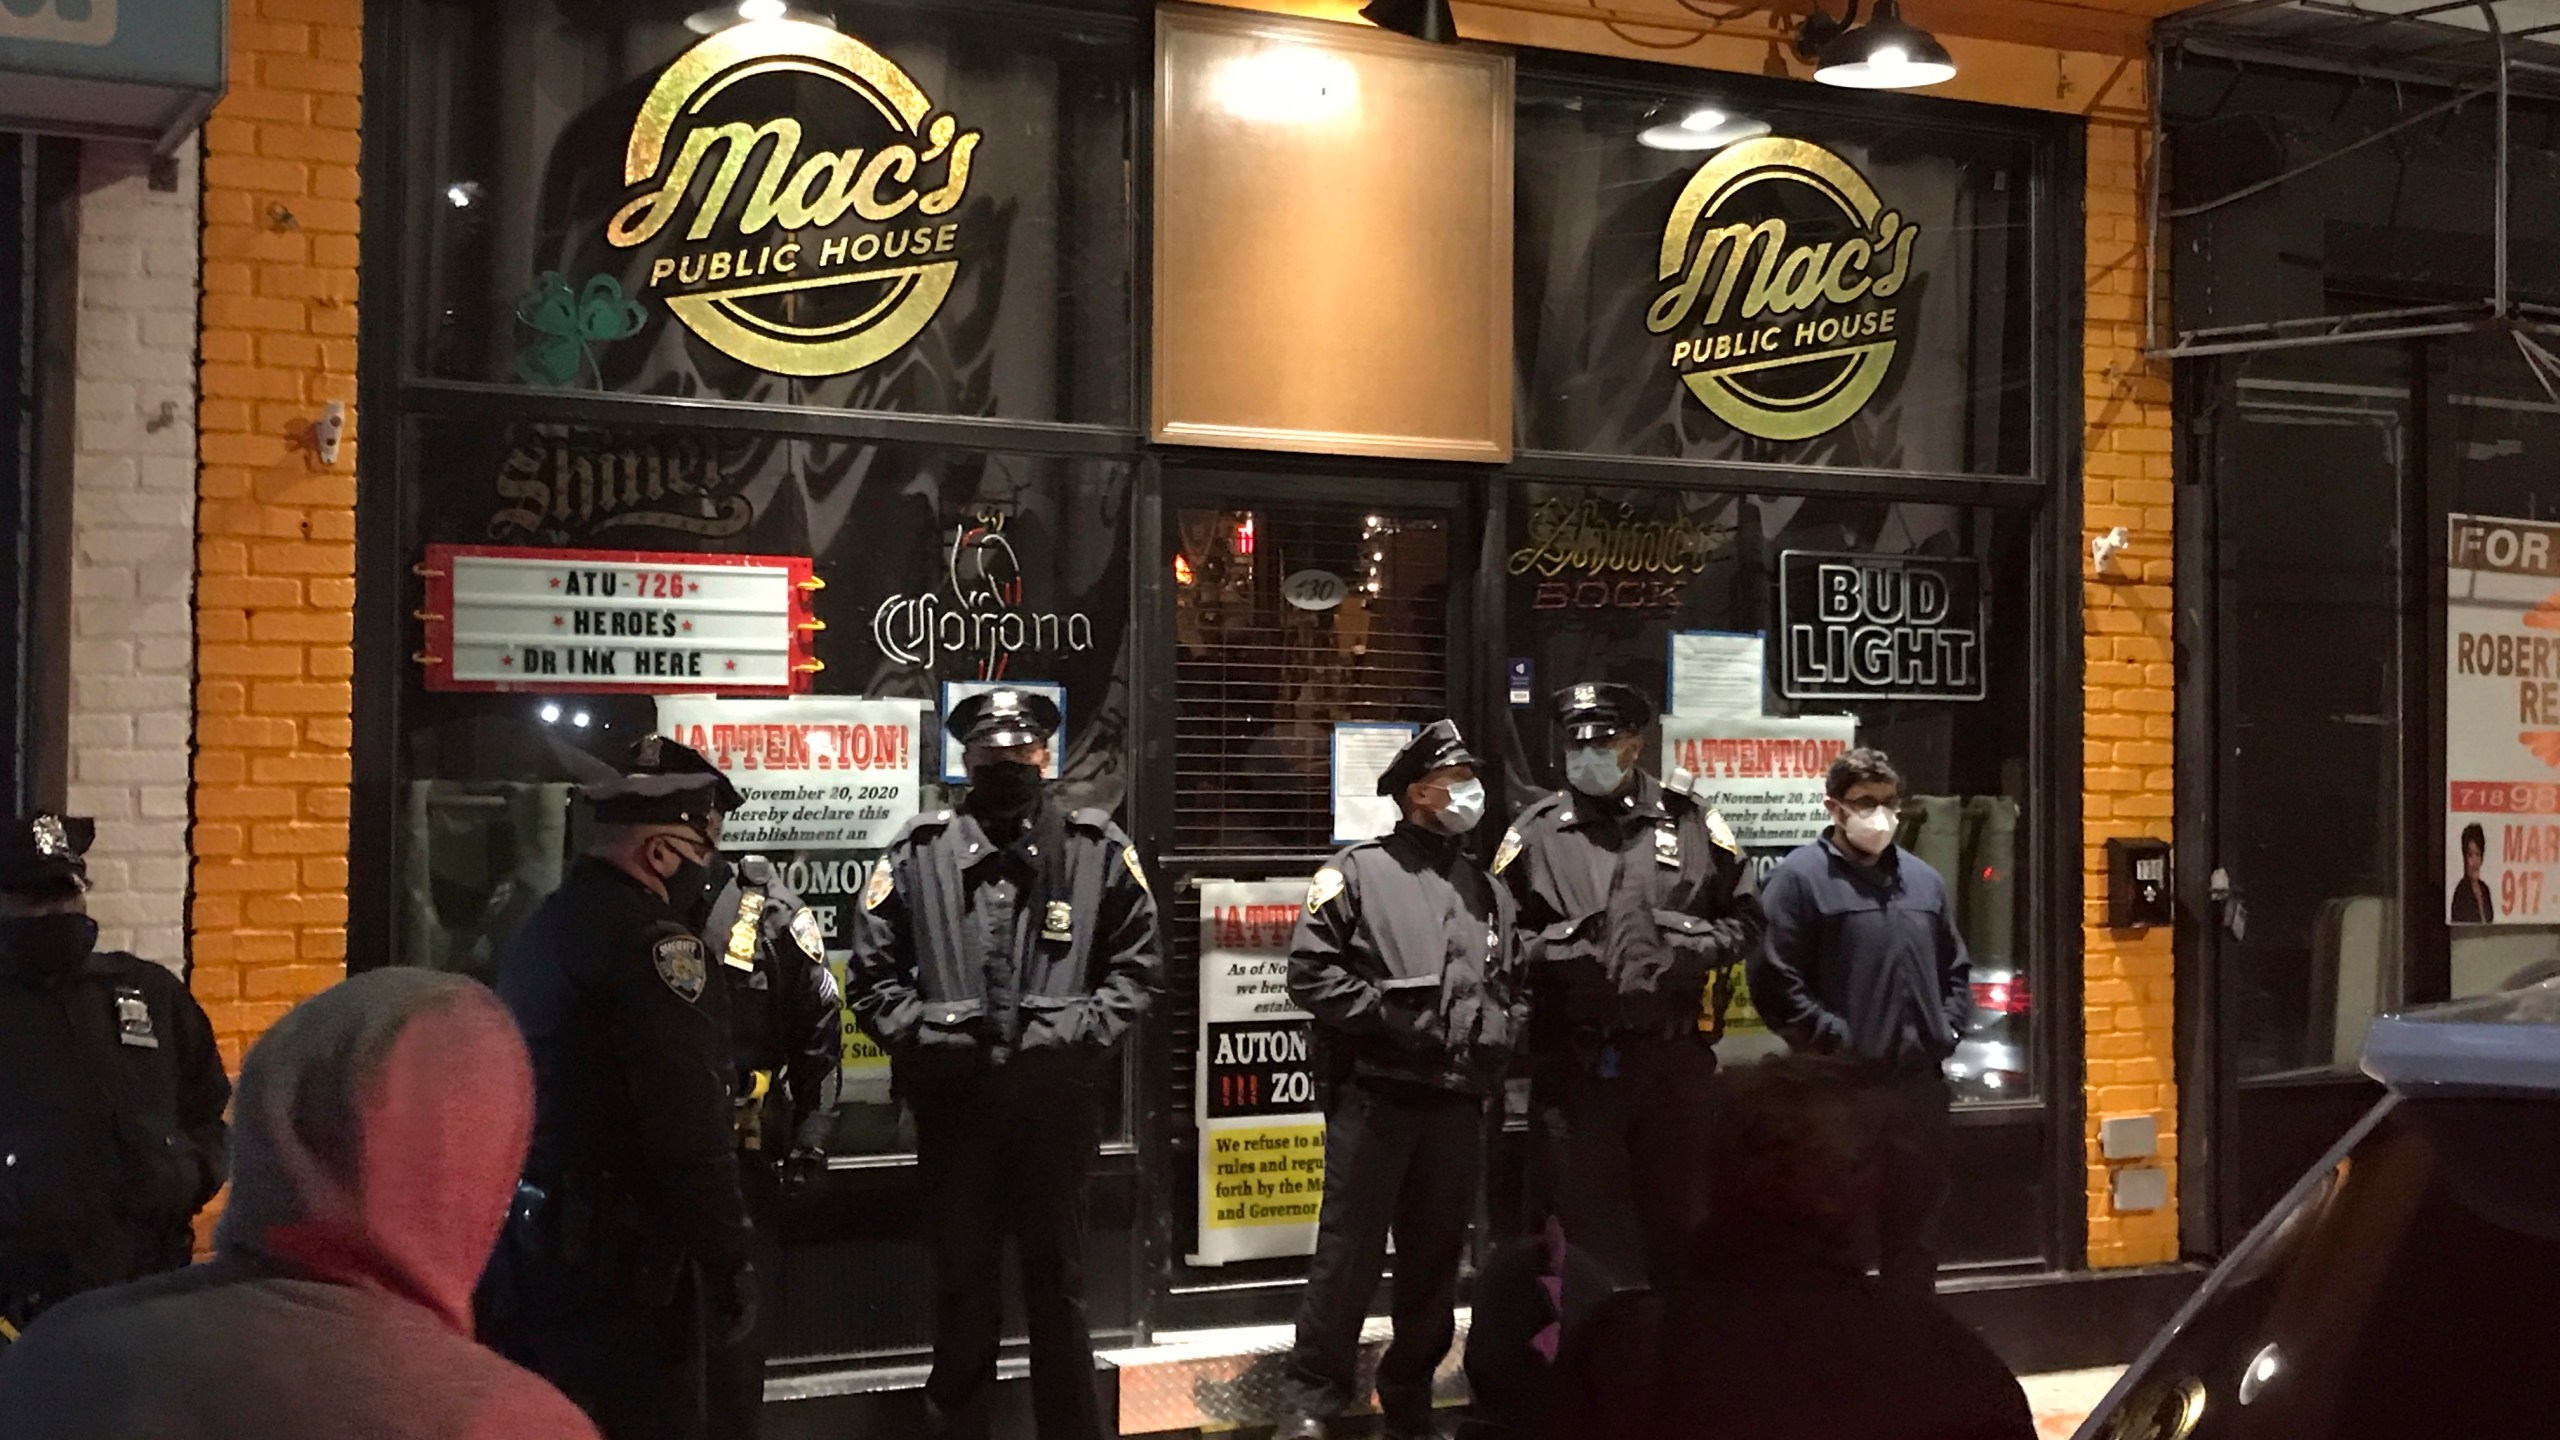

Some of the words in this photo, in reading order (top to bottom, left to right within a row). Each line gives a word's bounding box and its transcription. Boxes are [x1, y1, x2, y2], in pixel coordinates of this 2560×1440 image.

[606, 115, 981, 248] Mac's
[650, 242, 801, 287] PUBLIC
[819, 223, 959, 267] HOUSE
[1646, 211, 1918, 333] Mac's
[1671, 327, 1782, 367] PUBLIC
[1794, 308, 1897, 347] HOUSE
[1508, 498, 1710, 577] Shiner
[2458, 525, 2551, 570] FOR
[565, 570, 684, 599] ATU-726
[1532, 580, 1688, 610] BOCK
[1818, 563, 1949, 625] BUD
[573, 610, 677, 637] HEROES
[873, 592, 1094, 669] Corona
[523, 647, 616, 676] DRINK
[635, 650, 702, 677] HERE
[1791, 624, 1976, 686] LIGHT
[739, 785, 826, 801] November
[829, 786, 853, 804] 20,
[857, 786, 899, 800] 2020
[1720, 791, 1786, 804] November
[2459, 788, 2505, 807] 718
[728, 806, 790, 825] hereby
[791, 805, 855, 821] declare
[858, 805, 890, 821] this
[1719, 808, 1760, 825] ereby
[1761, 808, 1807, 822] declare
[1809, 808, 1831, 822] this
[721, 826, 842, 842] establishment
[846, 829, 867, 841] an
[1801, 829, 1817, 839] an
[2502, 823, 2560, 864] MAR
[2501, 869, 2544, 916] 917
[1227, 963, 1246, 976] As
[1249, 963, 1266, 976] of
[1236, 983, 1258, 995] we
[1216, 1138, 1240, 1152] We
[1243, 1133, 1290, 1151] refuse
[1294, 1134, 1308, 1148] to
[1217, 1158, 1256, 1176] rules
[1259, 1157, 1288, 1173] and
[1216, 1181, 1253, 1198] forth
[1257, 1179, 1275, 1198] by
[1279, 1179, 1302, 1194] the
[1217, 1203, 1245, 1221] and
[1249, 1202, 1318, 1219] Governor
